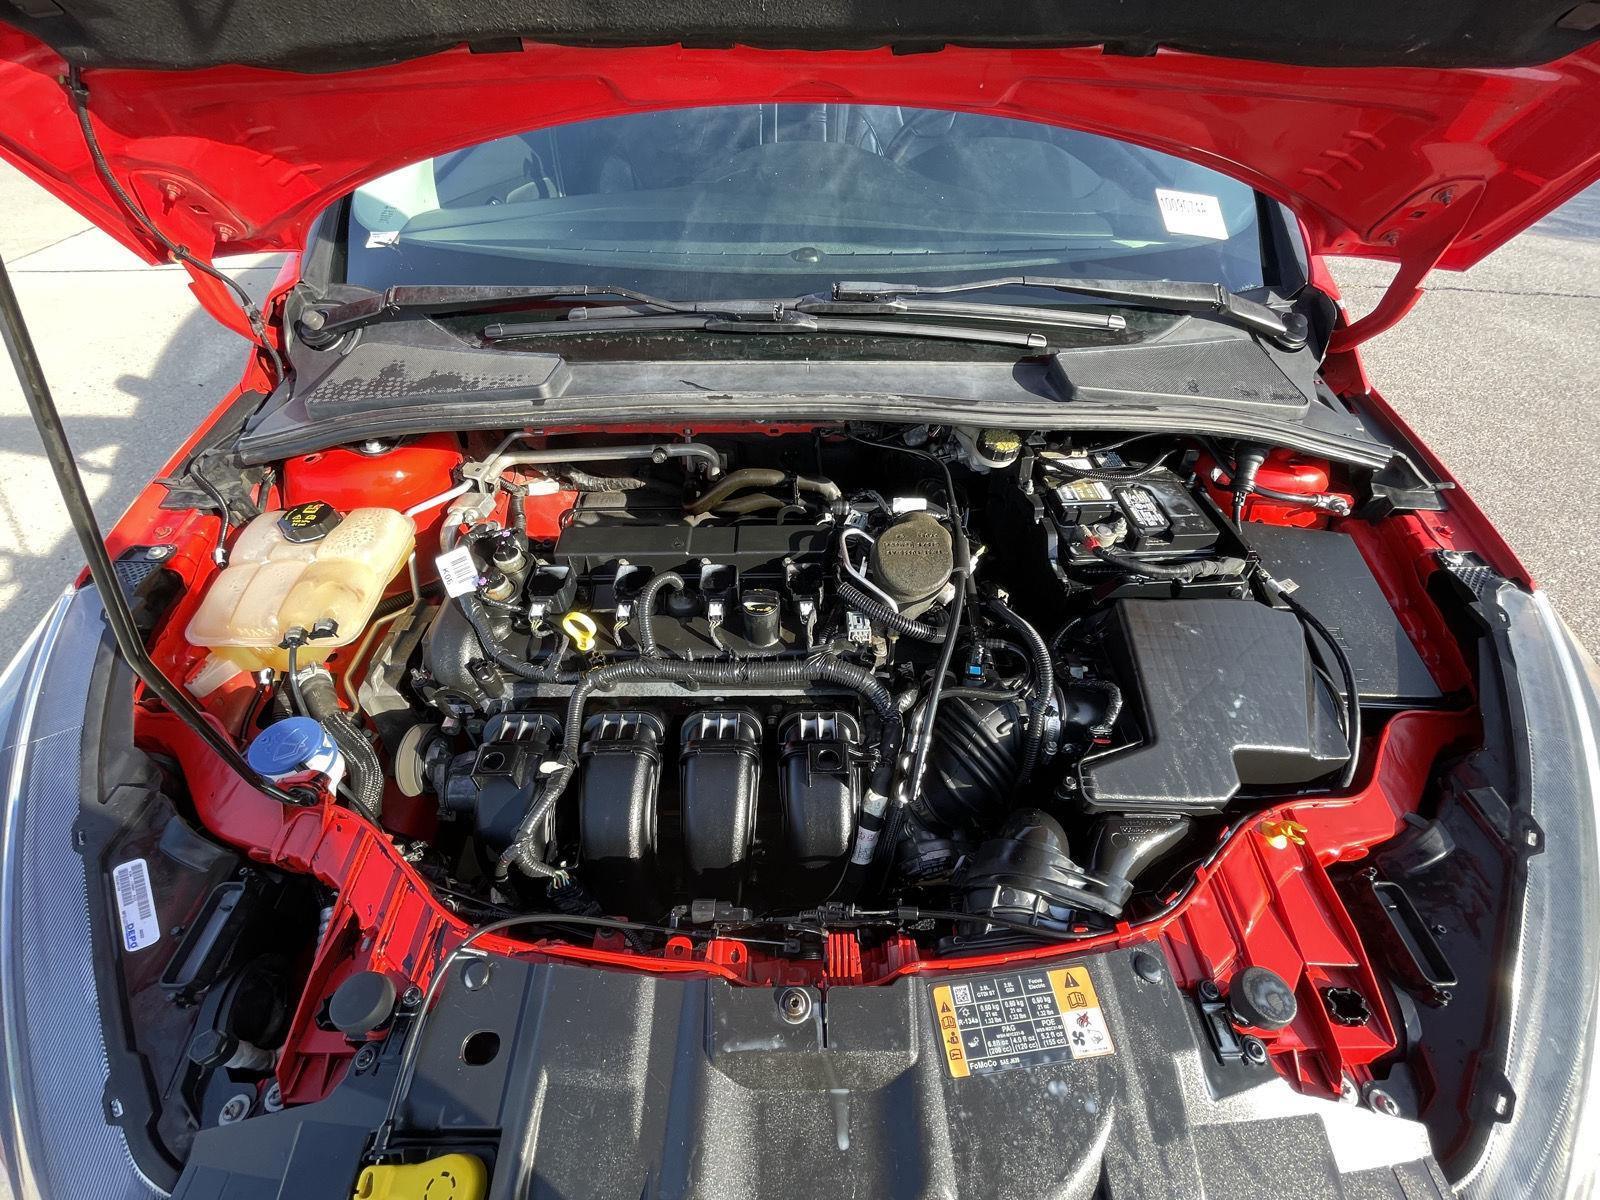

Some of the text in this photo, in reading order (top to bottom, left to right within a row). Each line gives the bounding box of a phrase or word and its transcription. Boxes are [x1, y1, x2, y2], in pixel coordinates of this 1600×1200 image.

[126, 923, 138, 948] DEPO
[958, 1017, 978, 1026] R-134a
[1041, 1019, 1056, 1027] POE
[1015, 1041, 1038, 1052] (120 cc)
[1043, 1037, 1066, 1048] (155 cc)
[1003, 1045, 1012, 1053] cc)
[970, 1060, 997, 1070] FoMoCo
